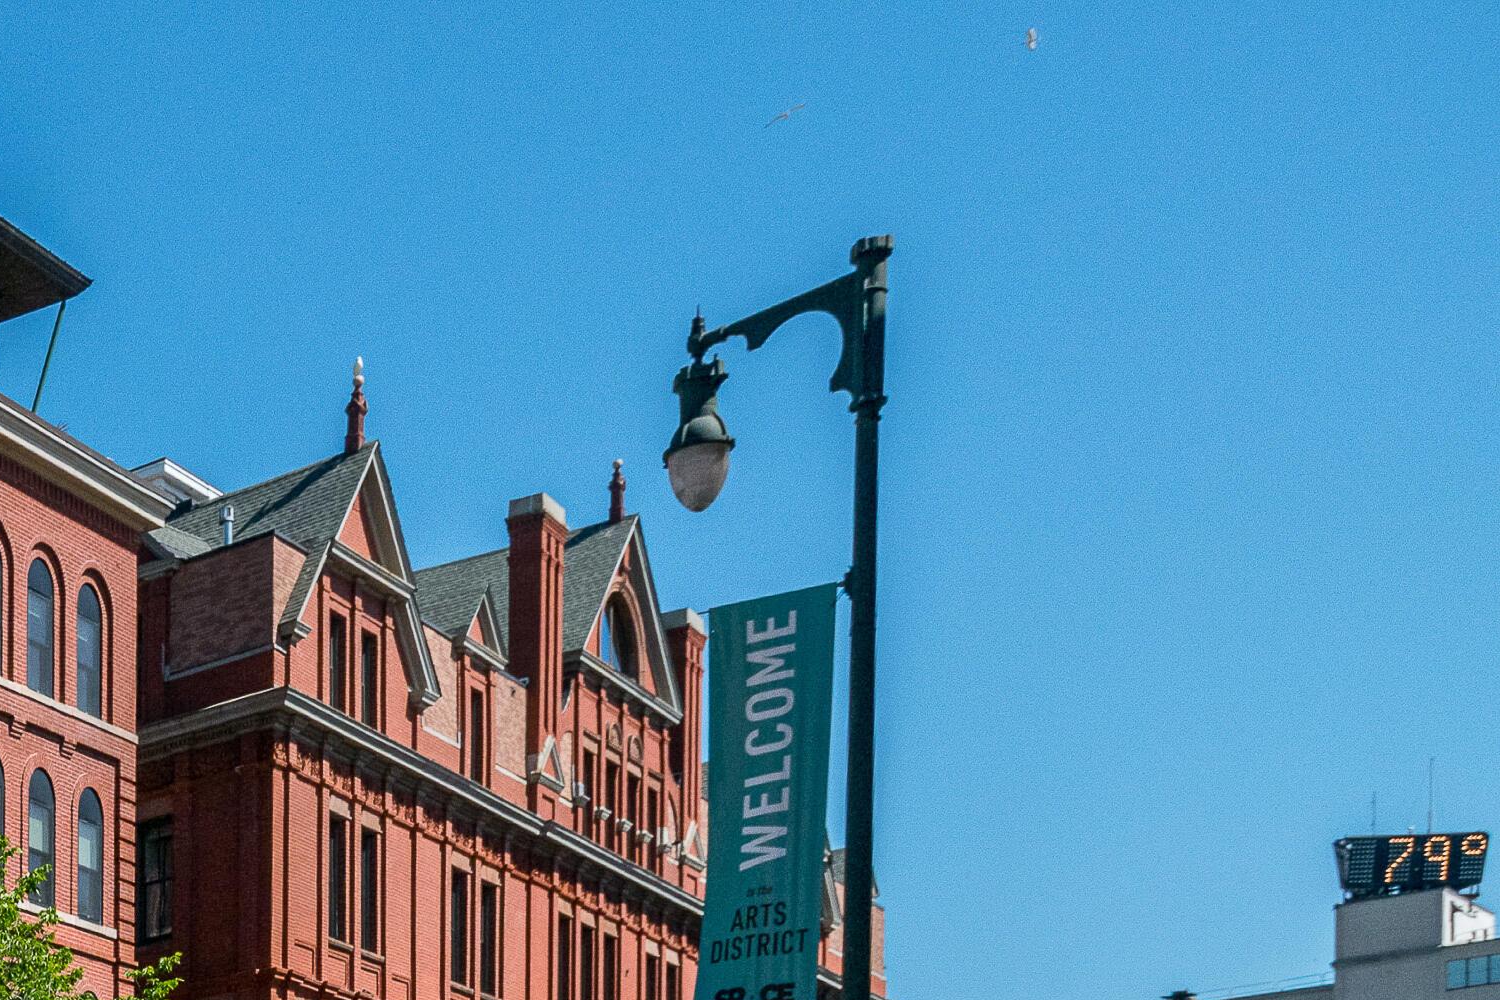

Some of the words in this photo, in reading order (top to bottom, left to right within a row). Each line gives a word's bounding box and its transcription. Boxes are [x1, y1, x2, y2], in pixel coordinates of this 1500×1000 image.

[739, 609, 798, 872] WELCOME
[730, 901, 787, 933] ARTS
[710, 928, 808, 964] DISTRICT
